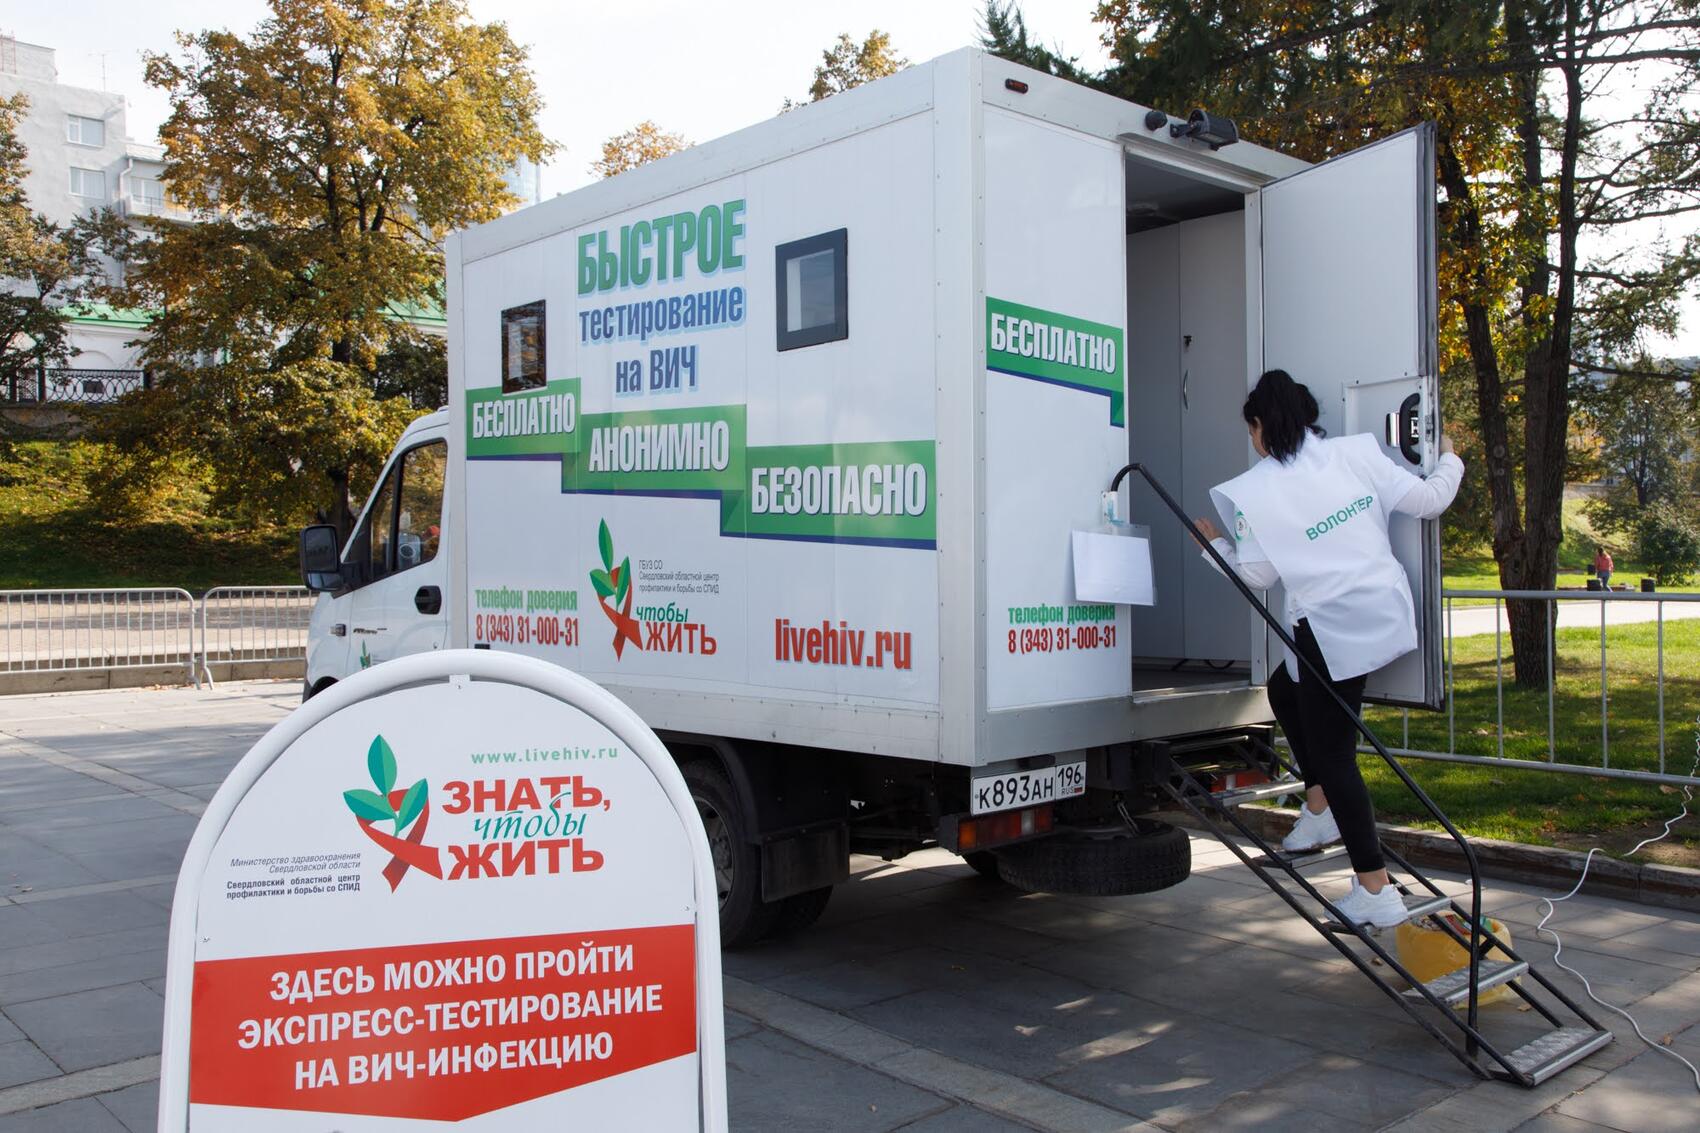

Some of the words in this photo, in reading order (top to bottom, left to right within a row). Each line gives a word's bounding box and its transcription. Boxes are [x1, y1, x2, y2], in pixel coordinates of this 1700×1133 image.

[578, 198, 745, 296] БЫСТРОЕ
[579, 286, 744, 342] тестирование
[991, 313, 1116, 374] БЕСПЛАТНО
[616, 358, 642, 394] на
[650, 345, 697, 391] ВИЧ
[472, 393, 575, 438] БЕСПЛАТНО
[588, 420, 729, 472] АНОНИМНО
[751, 463, 927, 516] БЕЗОПАСНО
[475, 585, 523, 612] телефон
[527, 590, 577, 613] доверия
[636, 602, 688, 622] чтобы
[1008, 603, 1063, 625] телефон
[1067, 604, 1116, 625] доверия
[476, 614, 483, 640] 8
[485, 615, 514, 644] (343)
[517, 616, 578, 646] 31-000-31
[645, 621, 717, 655] ЖИТЬ
[775, 618, 912, 671] livehiv.ru
[1008, 629, 1016, 653] 8
[1020, 628, 1053, 654] (343)
[1057, 625, 1116, 650] 31-000-31
[471, 746, 618, 764] www.livehiv.ru
[442, 775, 611, 815] ЗНАТЬ,
[980, 775, 1053, 809] К893АН
[1058, 765, 1081, 788] 196
[1061, 786, 1074, 795] RUS
[474, 792, 587, 840] чтобы
[230, 857, 289, 867] Министерство
[291, 852, 361, 864] здравоохранения
[269, 862, 326, 874] Свердловской
[328, 861, 361, 870] области
[447, 838, 604, 880] ЖИТЬ
[226, 889, 285, 900] профилактики
[294, 885, 324, 895] борьбы
[337, 882, 361, 892] СПИД
[227, 879, 285, 890] Свердловский
[290, 875, 332, 885] областной
[338, 874, 361, 883] центр
[270, 966, 375, 1005] ЗДЕСЬ
[384, 954, 506, 991] МОЖНО
[515, 941, 634, 978] ПРОЙТИ
[238, 984, 663, 1050] ЭКСПРЕСС-ТЕСТИРОВАНИЕ
[295, 1057, 337, 1090] НА
[348, 1031, 614, 1086] ВИЧ-ИНФЕКЦИЮ
